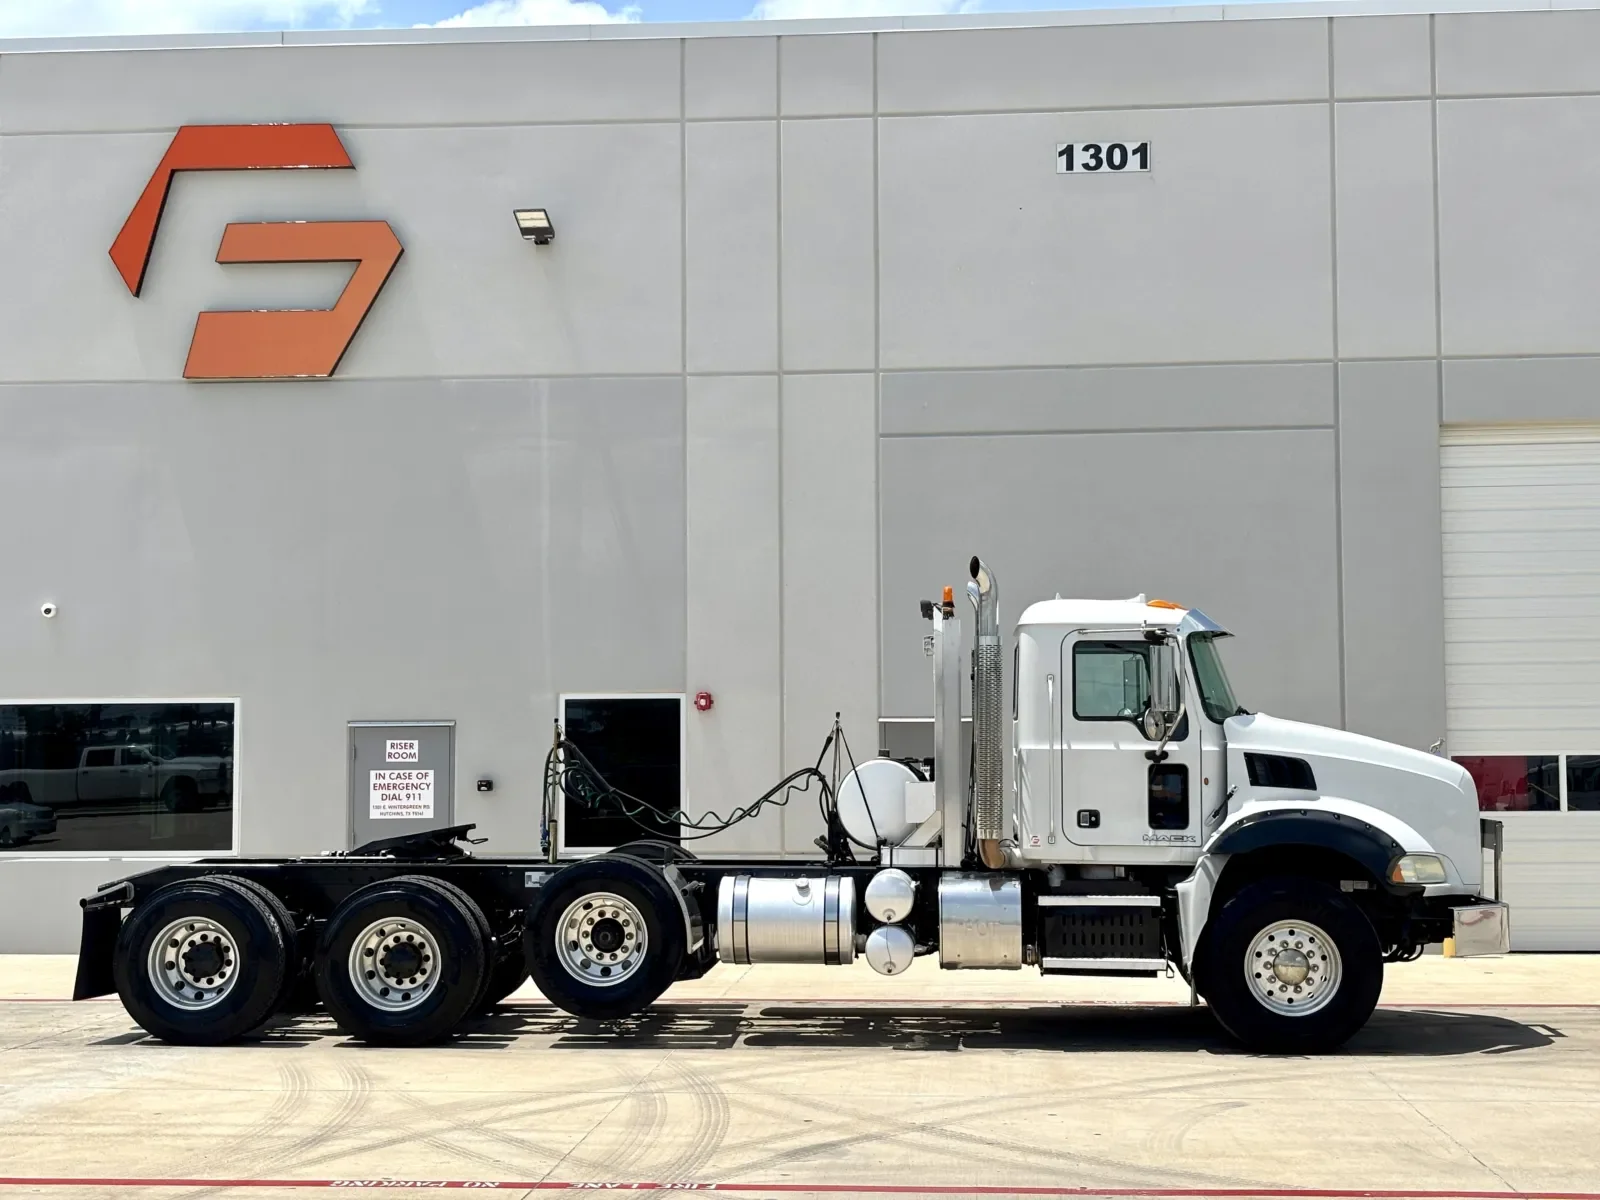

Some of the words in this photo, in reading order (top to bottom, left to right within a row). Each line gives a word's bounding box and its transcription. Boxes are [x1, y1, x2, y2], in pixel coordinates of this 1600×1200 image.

[1058, 142, 1148, 171] 1301
[390, 742, 414, 750] RISER
[388, 752, 417, 760] ROOM
[375, 772, 386, 780] IN
[389, 772, 413, 780] CASE
[416, 772, 430, 780] OF
[373, 782, 431, 791] EMERGENCY
[381, 793, 402, 801] DIAL
[405, 793, 422, 801] 911
[1142, 833, 1196, 843] MACK
[329, 1180, 447, 1188] PARKING
[568, 1182, 639, 1190] LANE
[657, 1182, 717, 1190] FIRE
